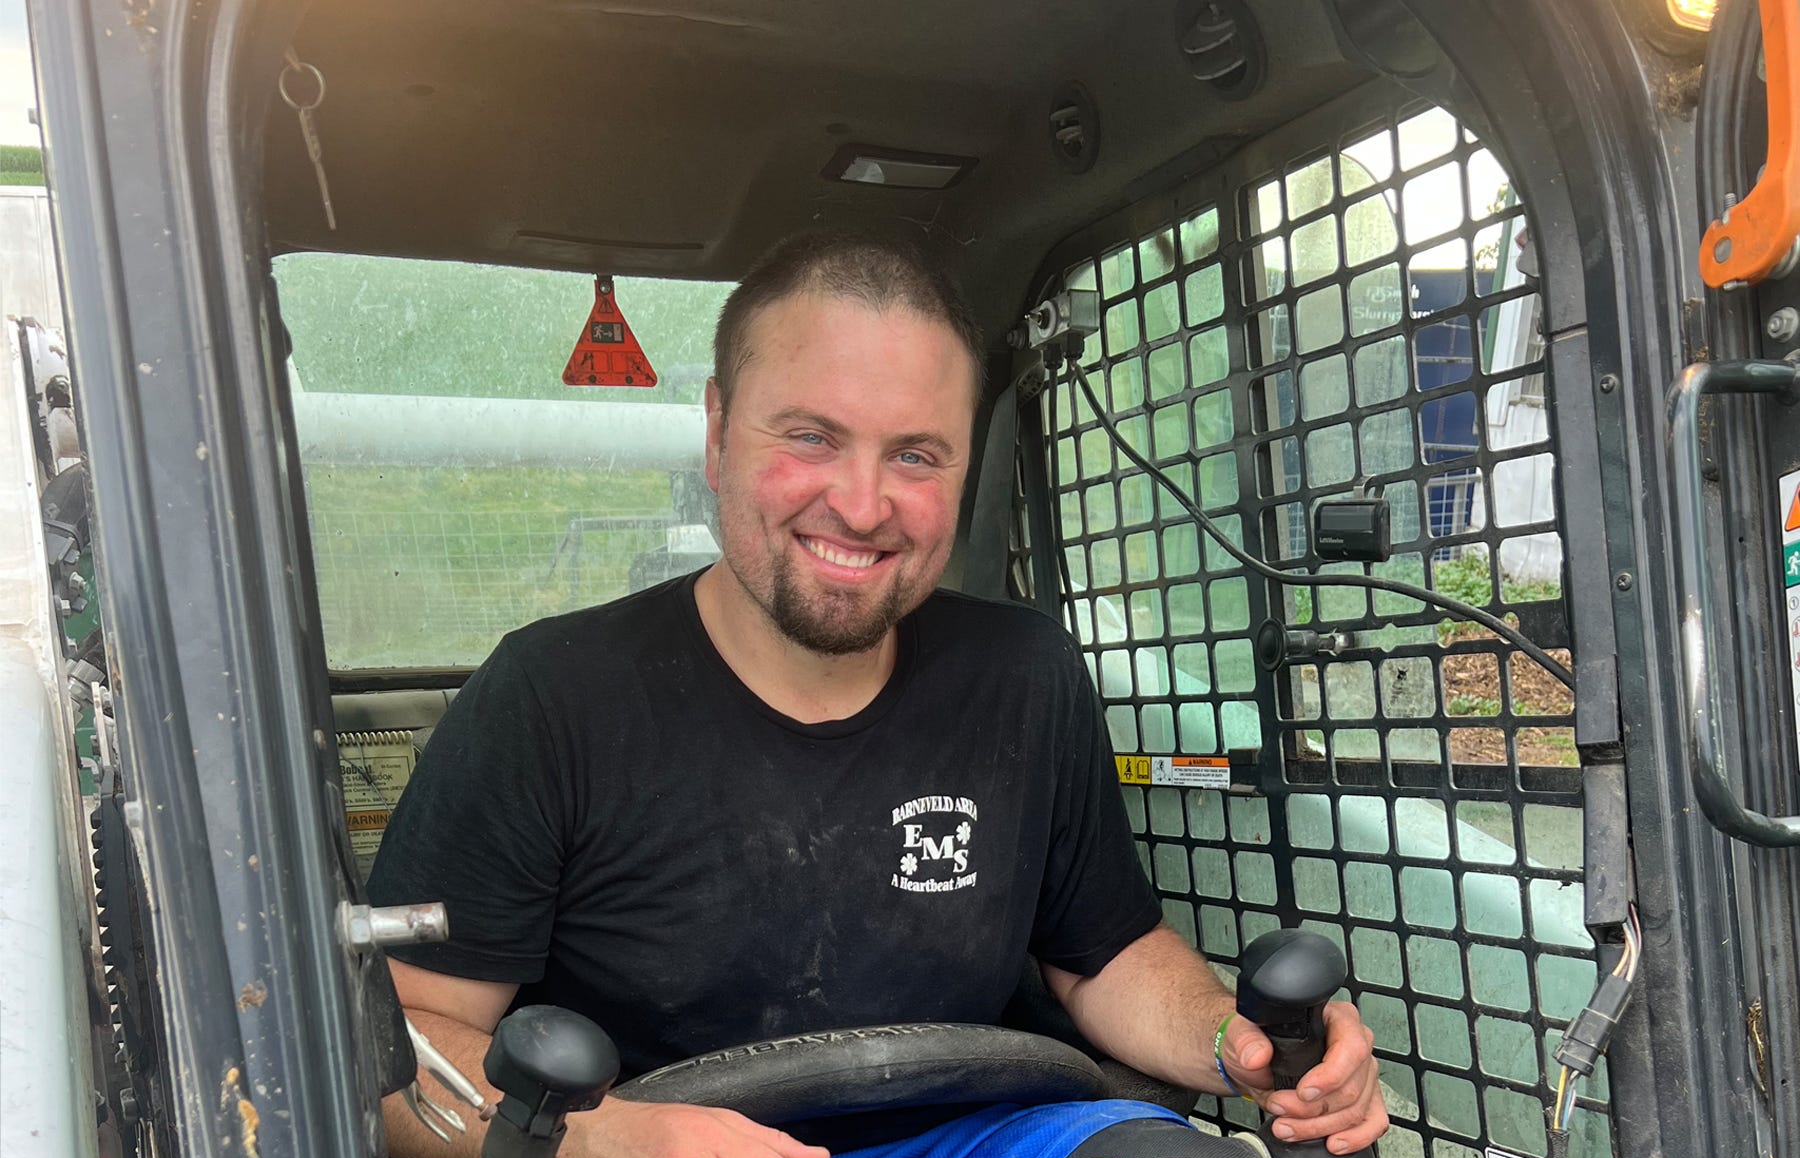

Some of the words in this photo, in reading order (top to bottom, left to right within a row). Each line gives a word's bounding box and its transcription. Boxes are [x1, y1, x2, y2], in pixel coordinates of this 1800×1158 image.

[892, 796, 954, 826] BARNEVELD
[954, 797, 977, 821] AREA
[903, 824, 968, 872] EMS
[891, 873, 899, 887] A
[900, 876, 954, 892] Heartbeat
[955, 872, 977, 890] Away
